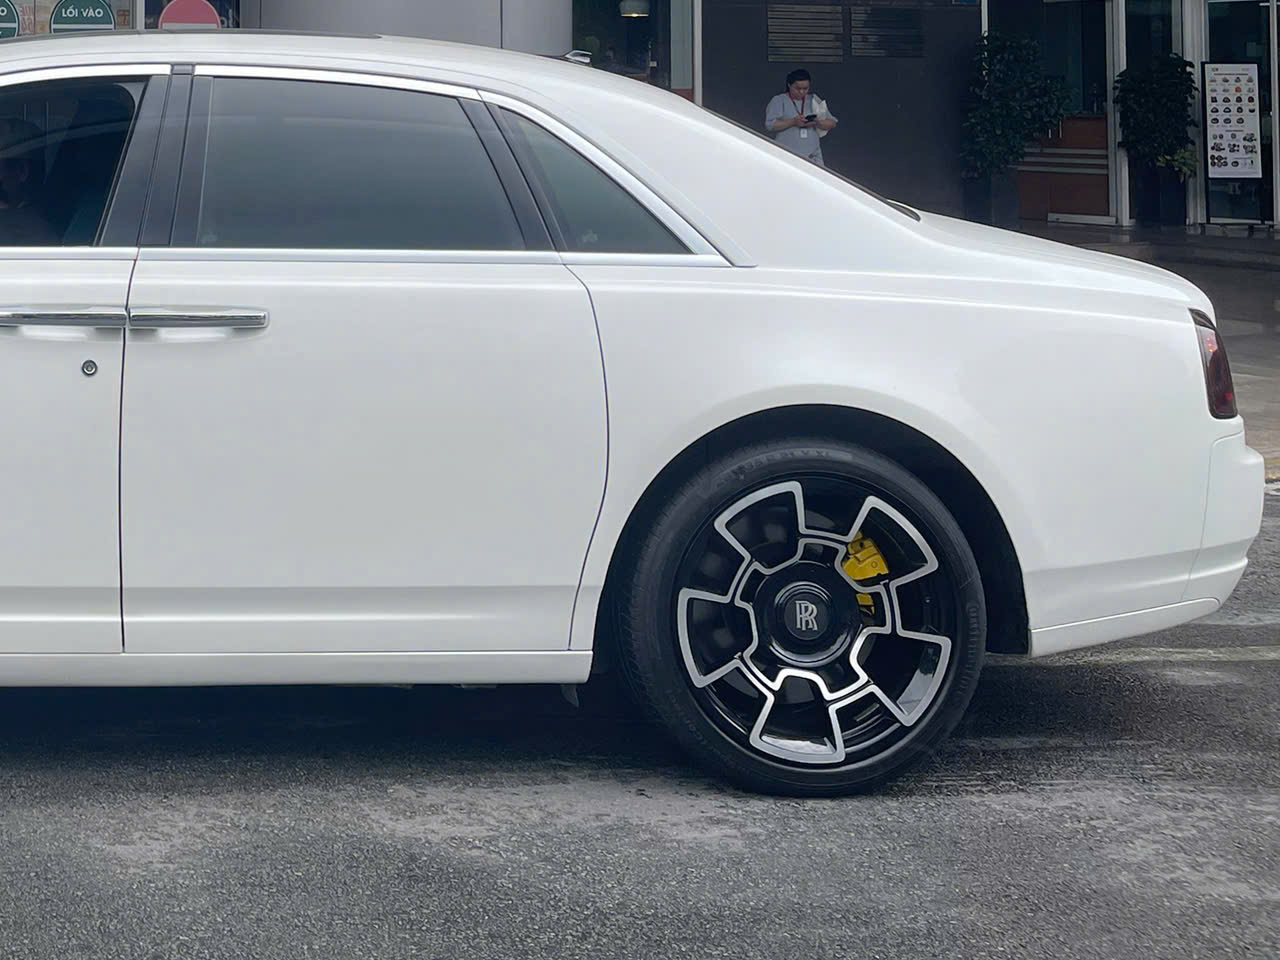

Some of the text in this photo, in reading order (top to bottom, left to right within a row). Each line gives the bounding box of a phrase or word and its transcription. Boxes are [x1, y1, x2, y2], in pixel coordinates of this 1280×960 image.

[62, 4, 104, 17] LỐI VÀO
[795, 600, 818, 631] RR
